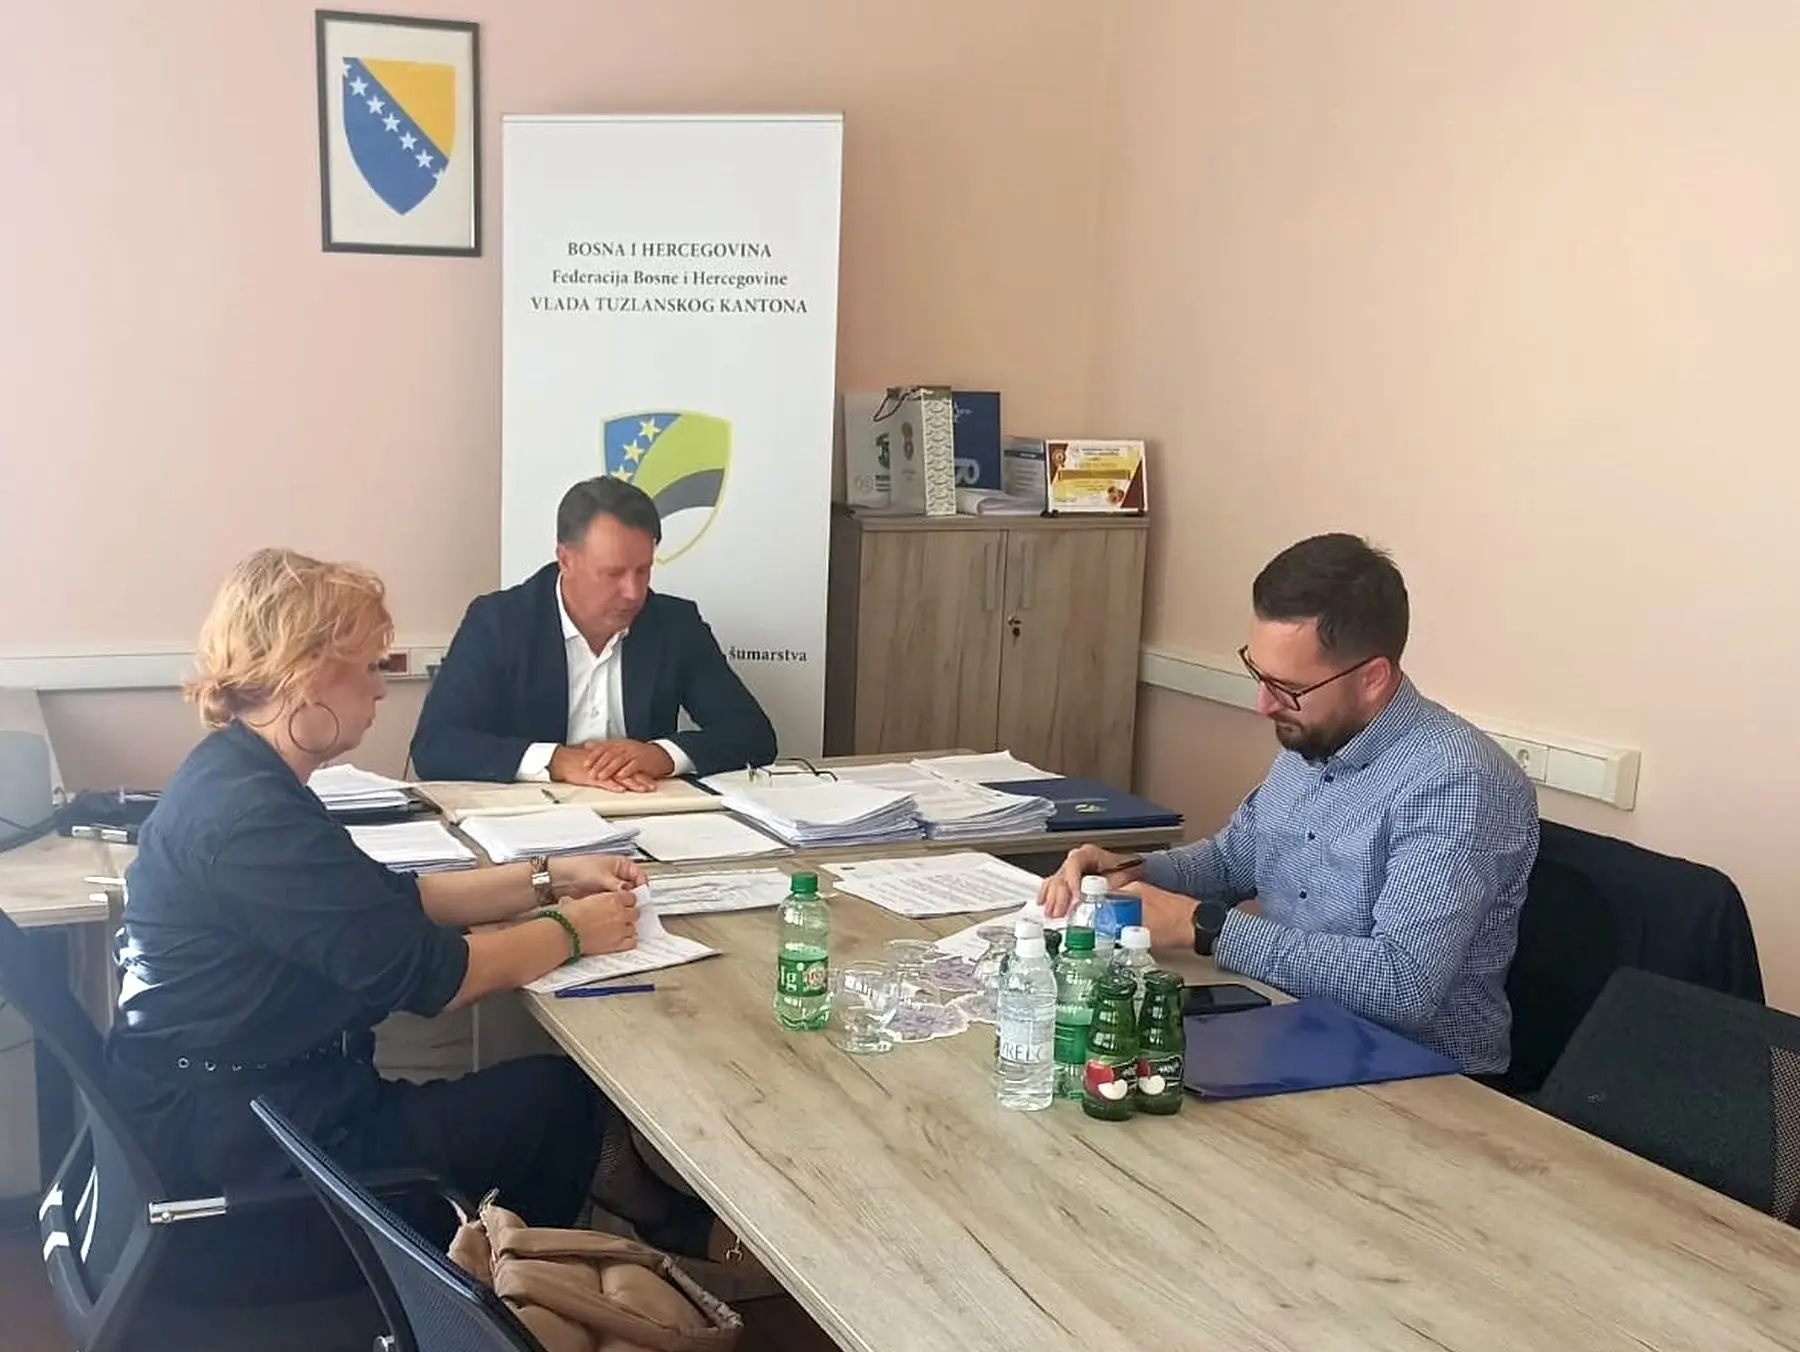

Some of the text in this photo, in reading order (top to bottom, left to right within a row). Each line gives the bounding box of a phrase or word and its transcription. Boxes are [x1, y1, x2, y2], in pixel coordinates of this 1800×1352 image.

[567, 241, 772, 258] BOSNA I HERCEGOVINA
[552, 269, 788, 290] Federacija Bosne i Hercegovine
[530, 296, 808, 313] VLADA TUZLANSKOG KANTONA
[728, 646, 808, 662] šumarstva
